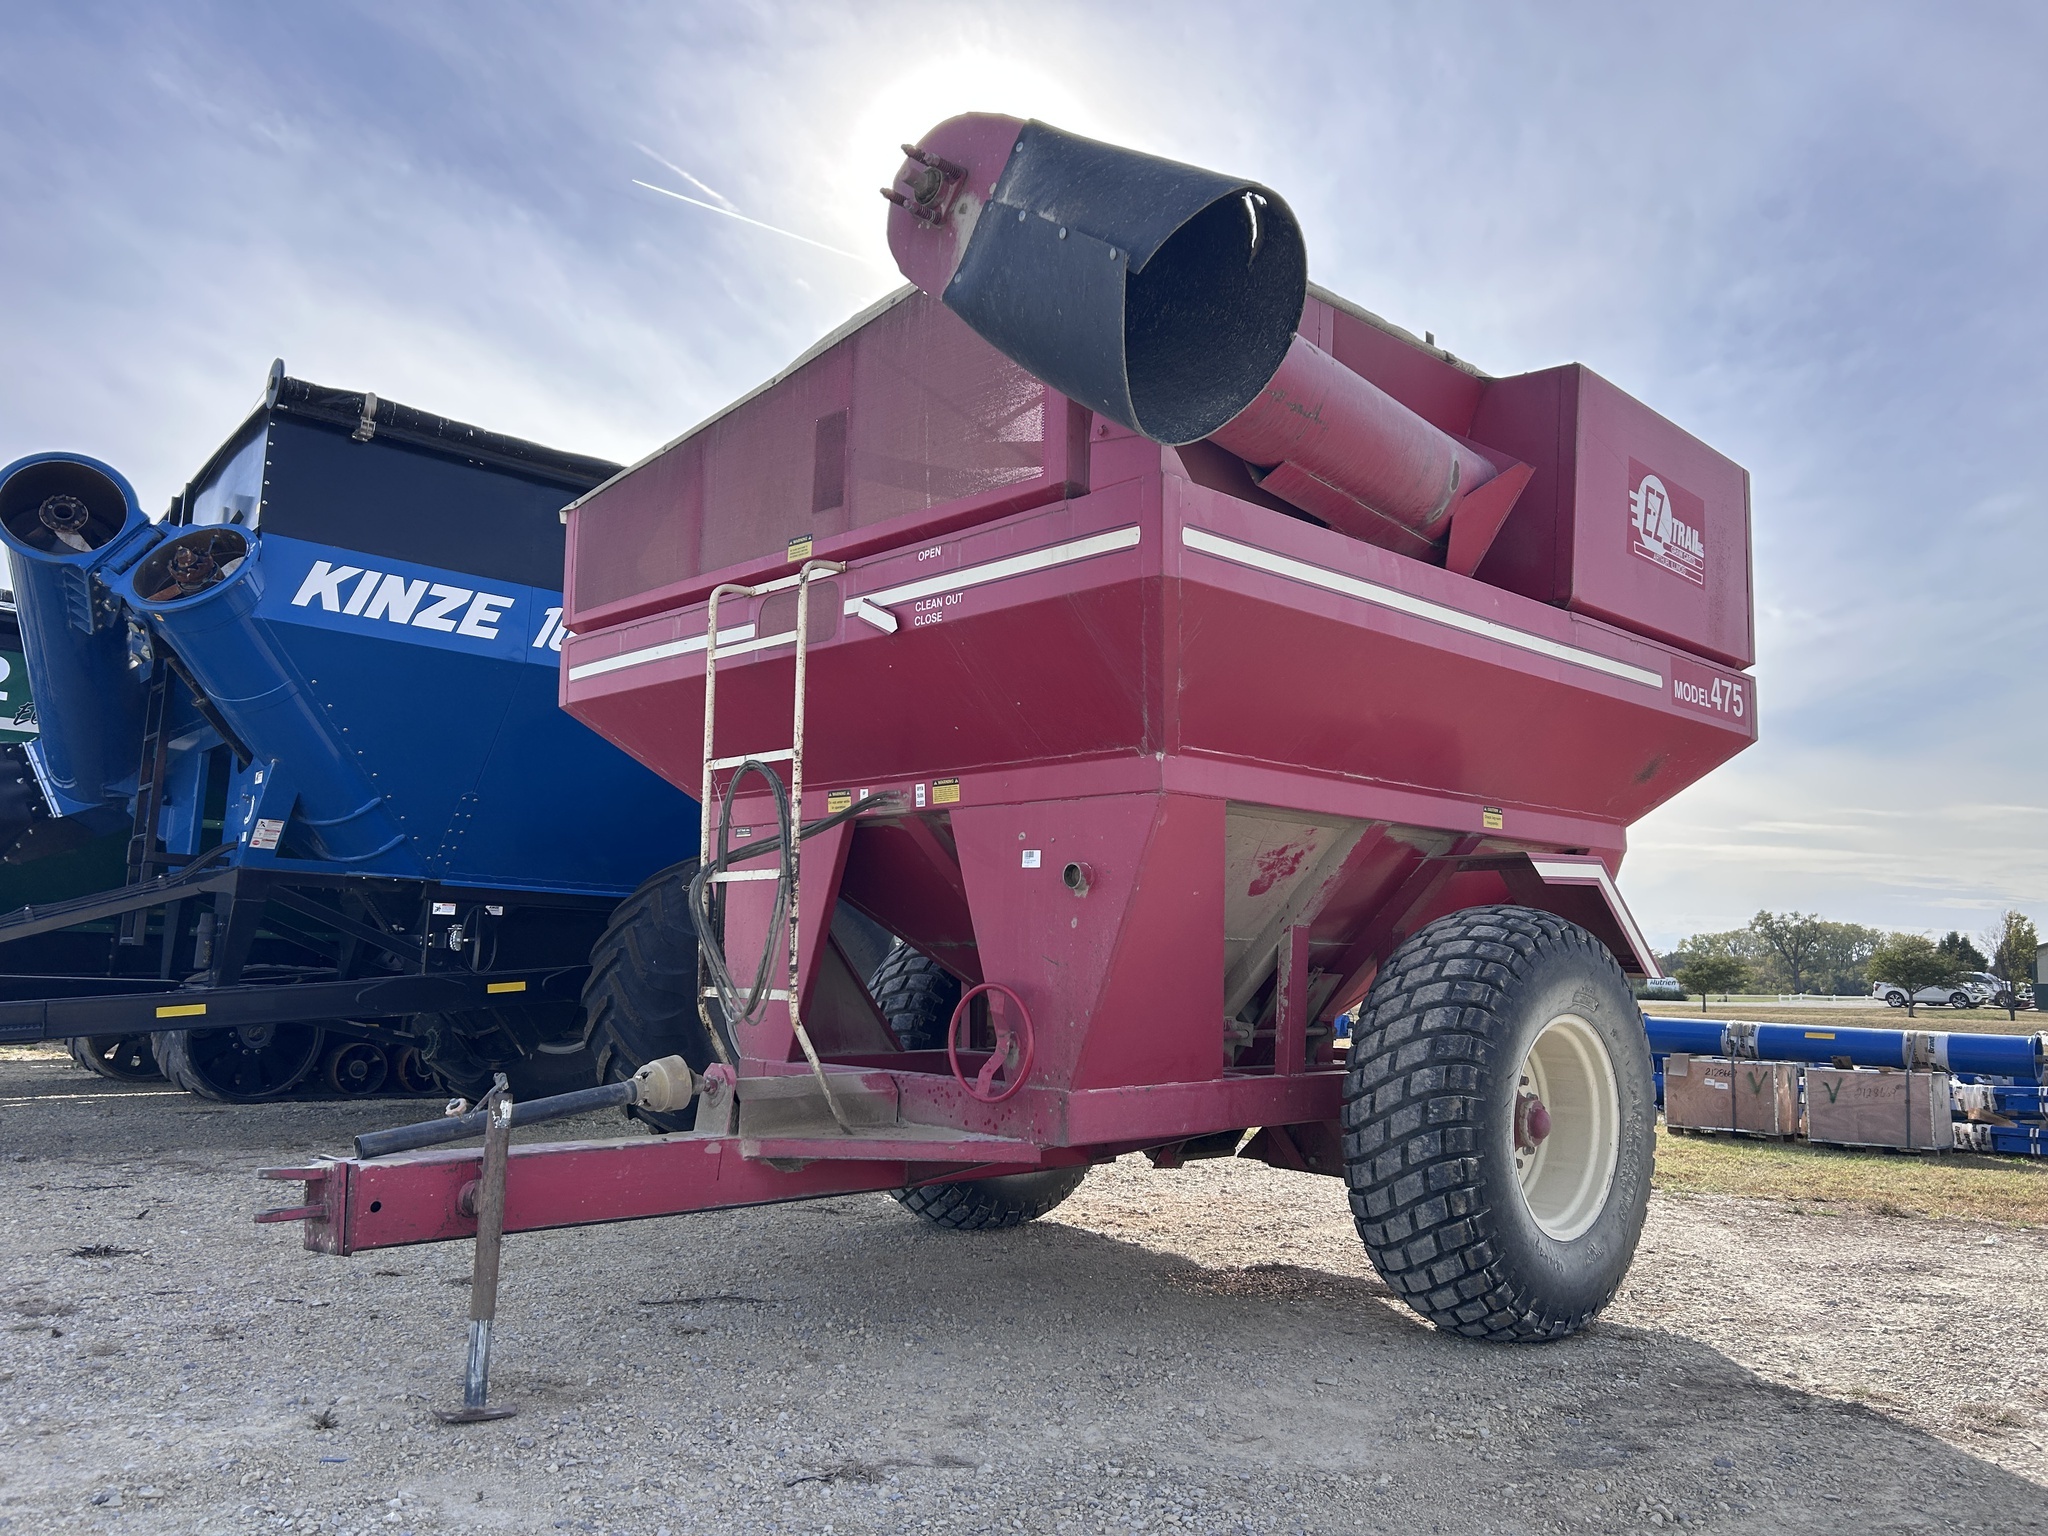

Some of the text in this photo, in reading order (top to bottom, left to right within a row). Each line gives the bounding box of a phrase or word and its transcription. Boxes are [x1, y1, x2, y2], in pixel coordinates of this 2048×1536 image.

[1643, 485, 1665, 543] EZ
[918, 545, 942, 562] OPEN
[1672, 517, 1704, 558] TRAIL
[291, 560, 516, 640] KINZE
[914, 611, 943, 626] CLOSE
[915, 592, 964, 612] CLEAN OUT
[1674, 677, 1744, 718] MODEL 475
